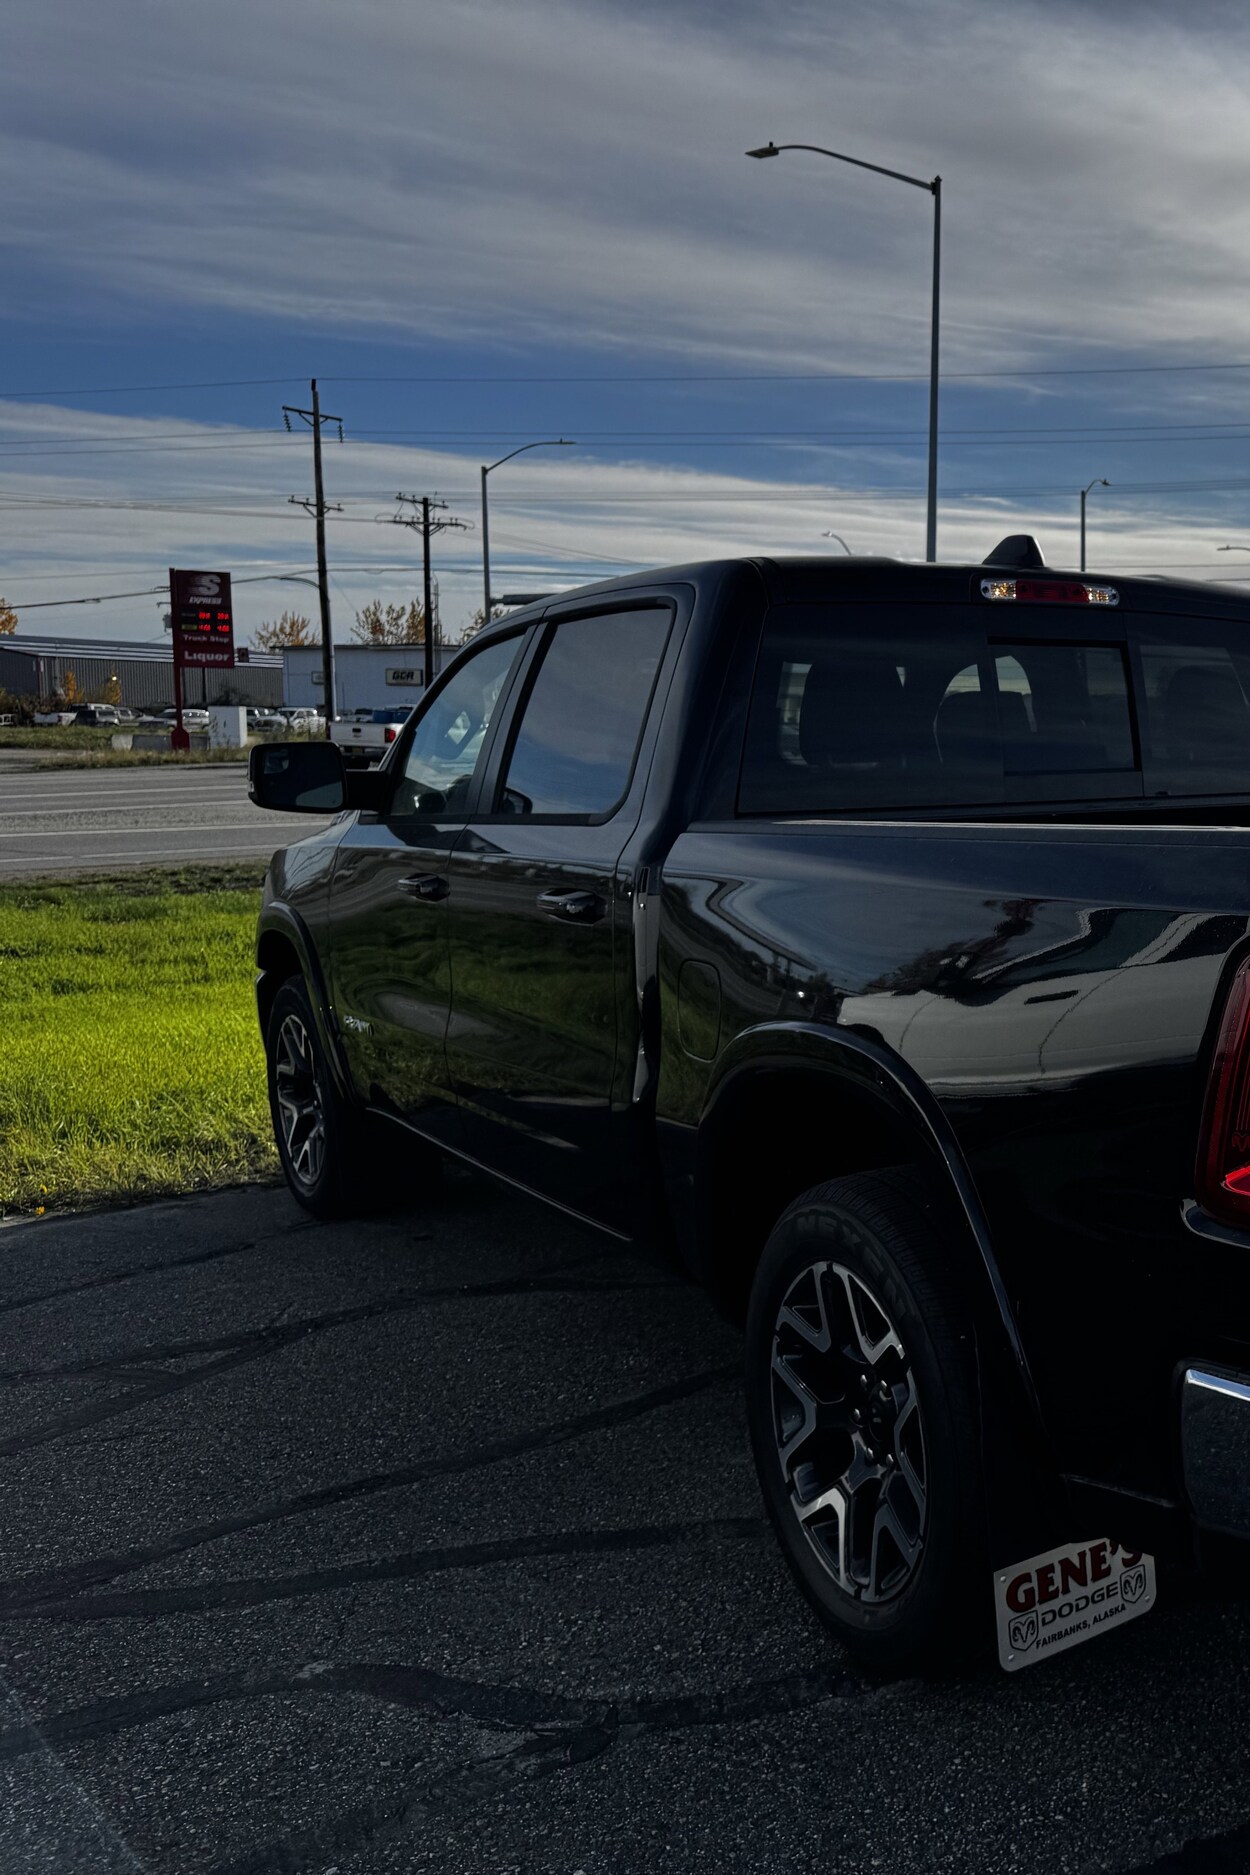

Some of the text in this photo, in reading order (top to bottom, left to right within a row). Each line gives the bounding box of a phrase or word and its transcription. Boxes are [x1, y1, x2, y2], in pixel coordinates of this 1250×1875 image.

[183, 633, 230, 644] Truck Stop
[184, 650, 230, 663] Liquor
[1042, 1582, 1119, 1626] DODGE
[1036, 1603, 1127, 1649] FAIRBANKS, ALASKA
